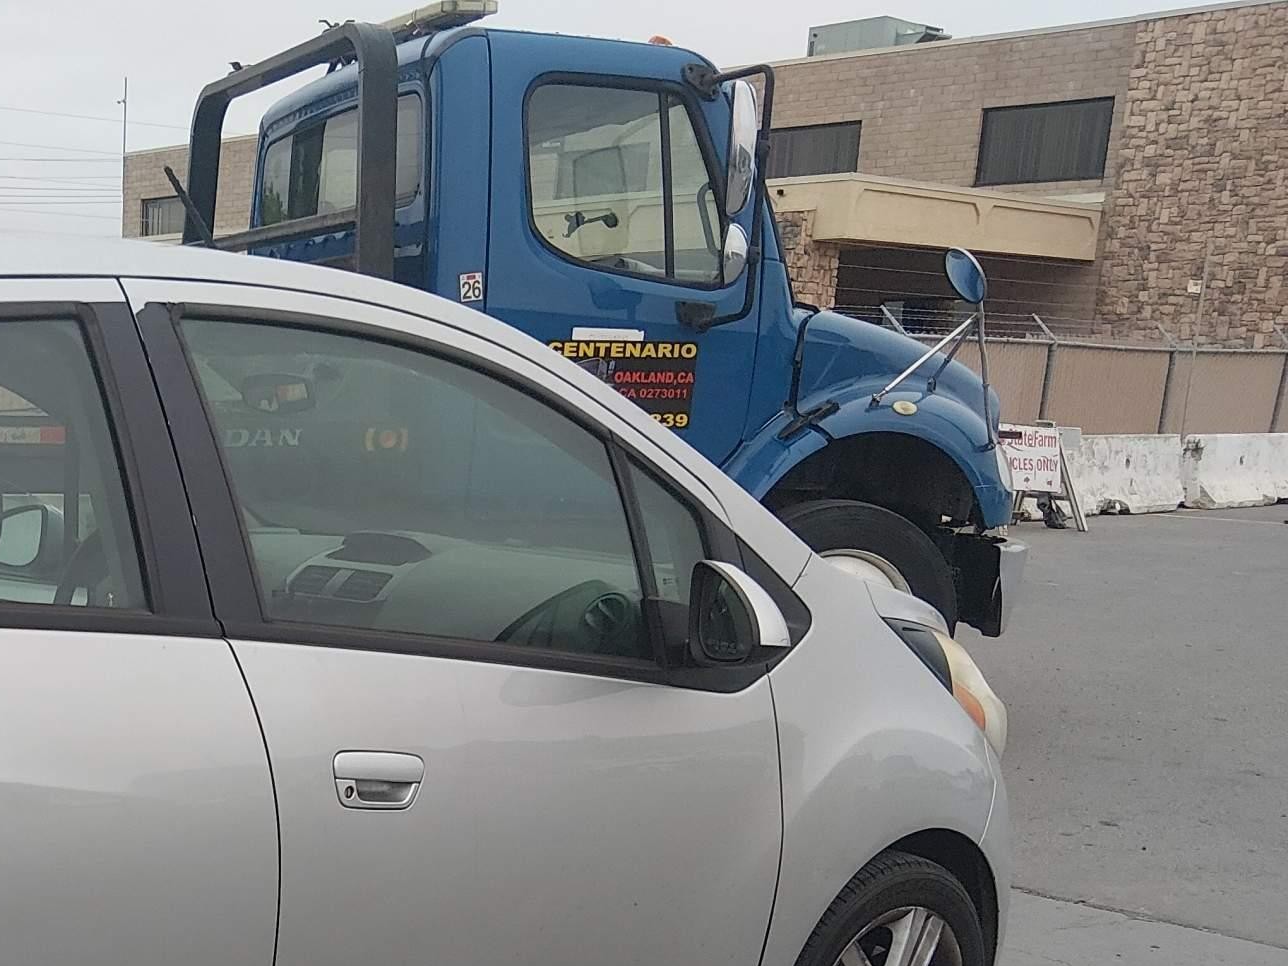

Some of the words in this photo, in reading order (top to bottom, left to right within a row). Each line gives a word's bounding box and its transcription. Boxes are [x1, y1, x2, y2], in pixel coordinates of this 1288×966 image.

[462, 280, 482, 300] 26
[549, 342, 697, 359] CENTENARIO
[614, 371, 695, 385] OAKLAND,CA
[639, 388, 687, 399] 0273011
[1036, 458, 1058, 472] ONLY
